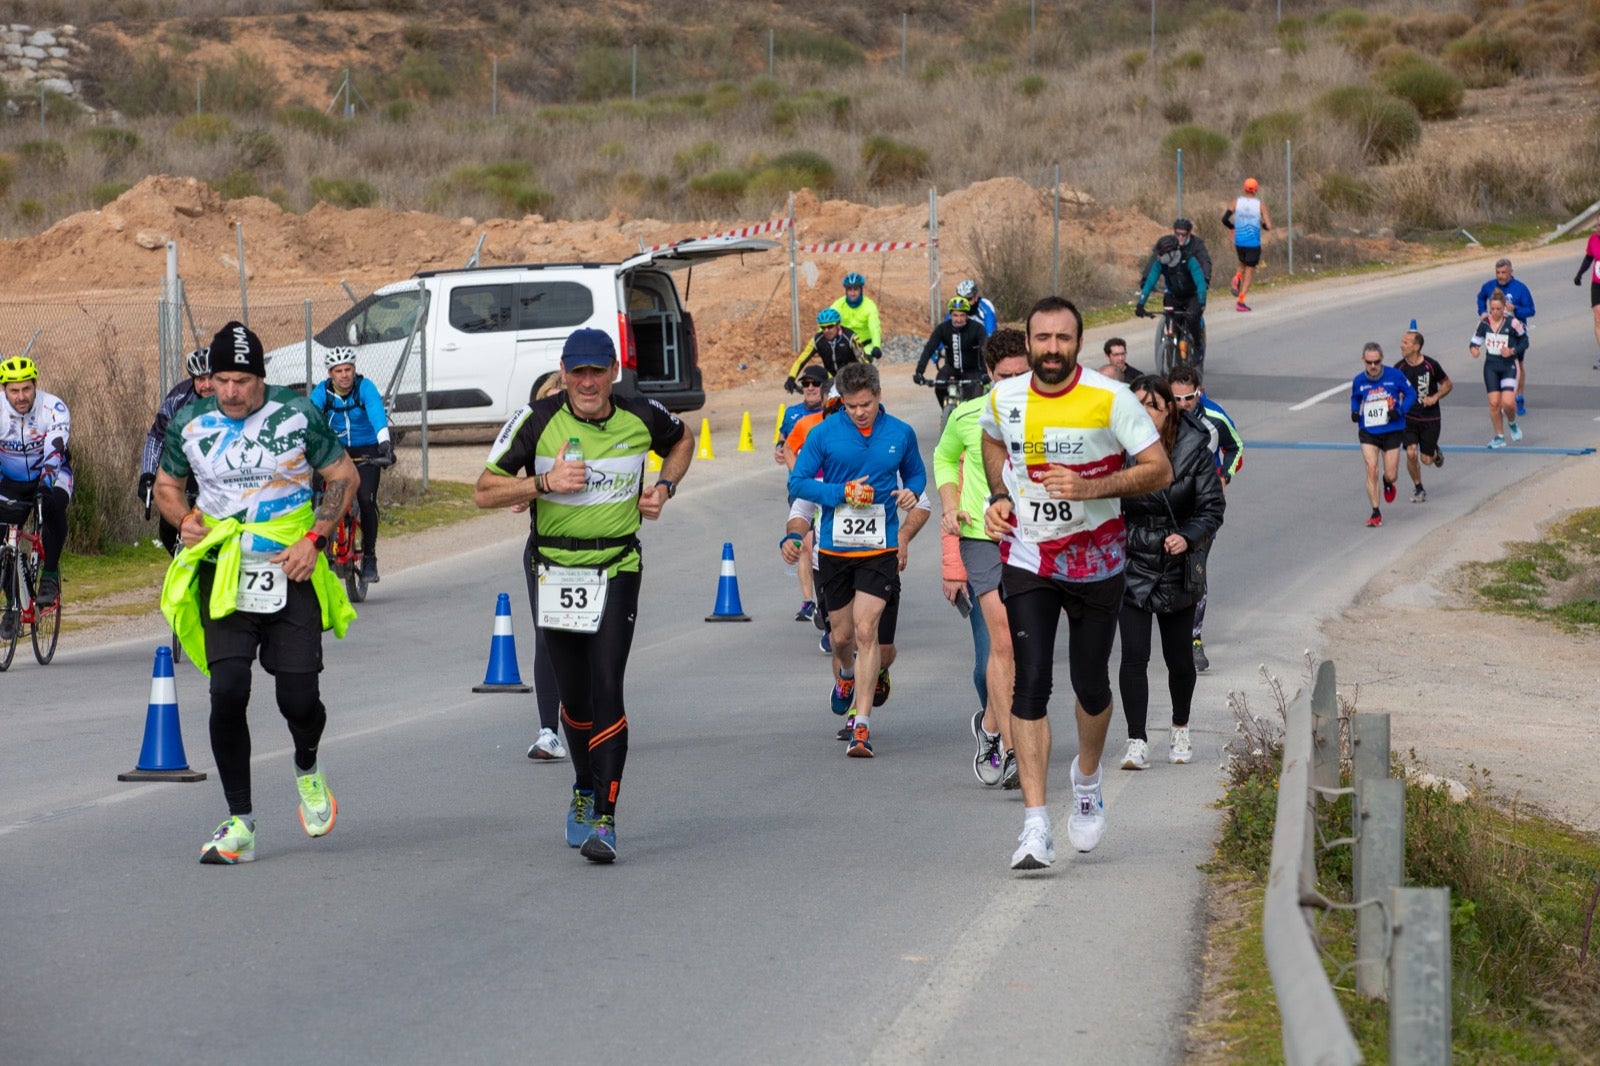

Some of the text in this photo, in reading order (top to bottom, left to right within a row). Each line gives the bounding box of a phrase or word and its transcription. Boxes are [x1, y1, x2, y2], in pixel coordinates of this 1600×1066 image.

[233, 326, 250, 364] PUMA
[1368, 408, 1384, 418] 487
[1030, 501, 1073, 522] 798
[843, 518, 877, 535] 324
[245, 570, 274, 592] 73
[560, 587, 588, 609] 53
